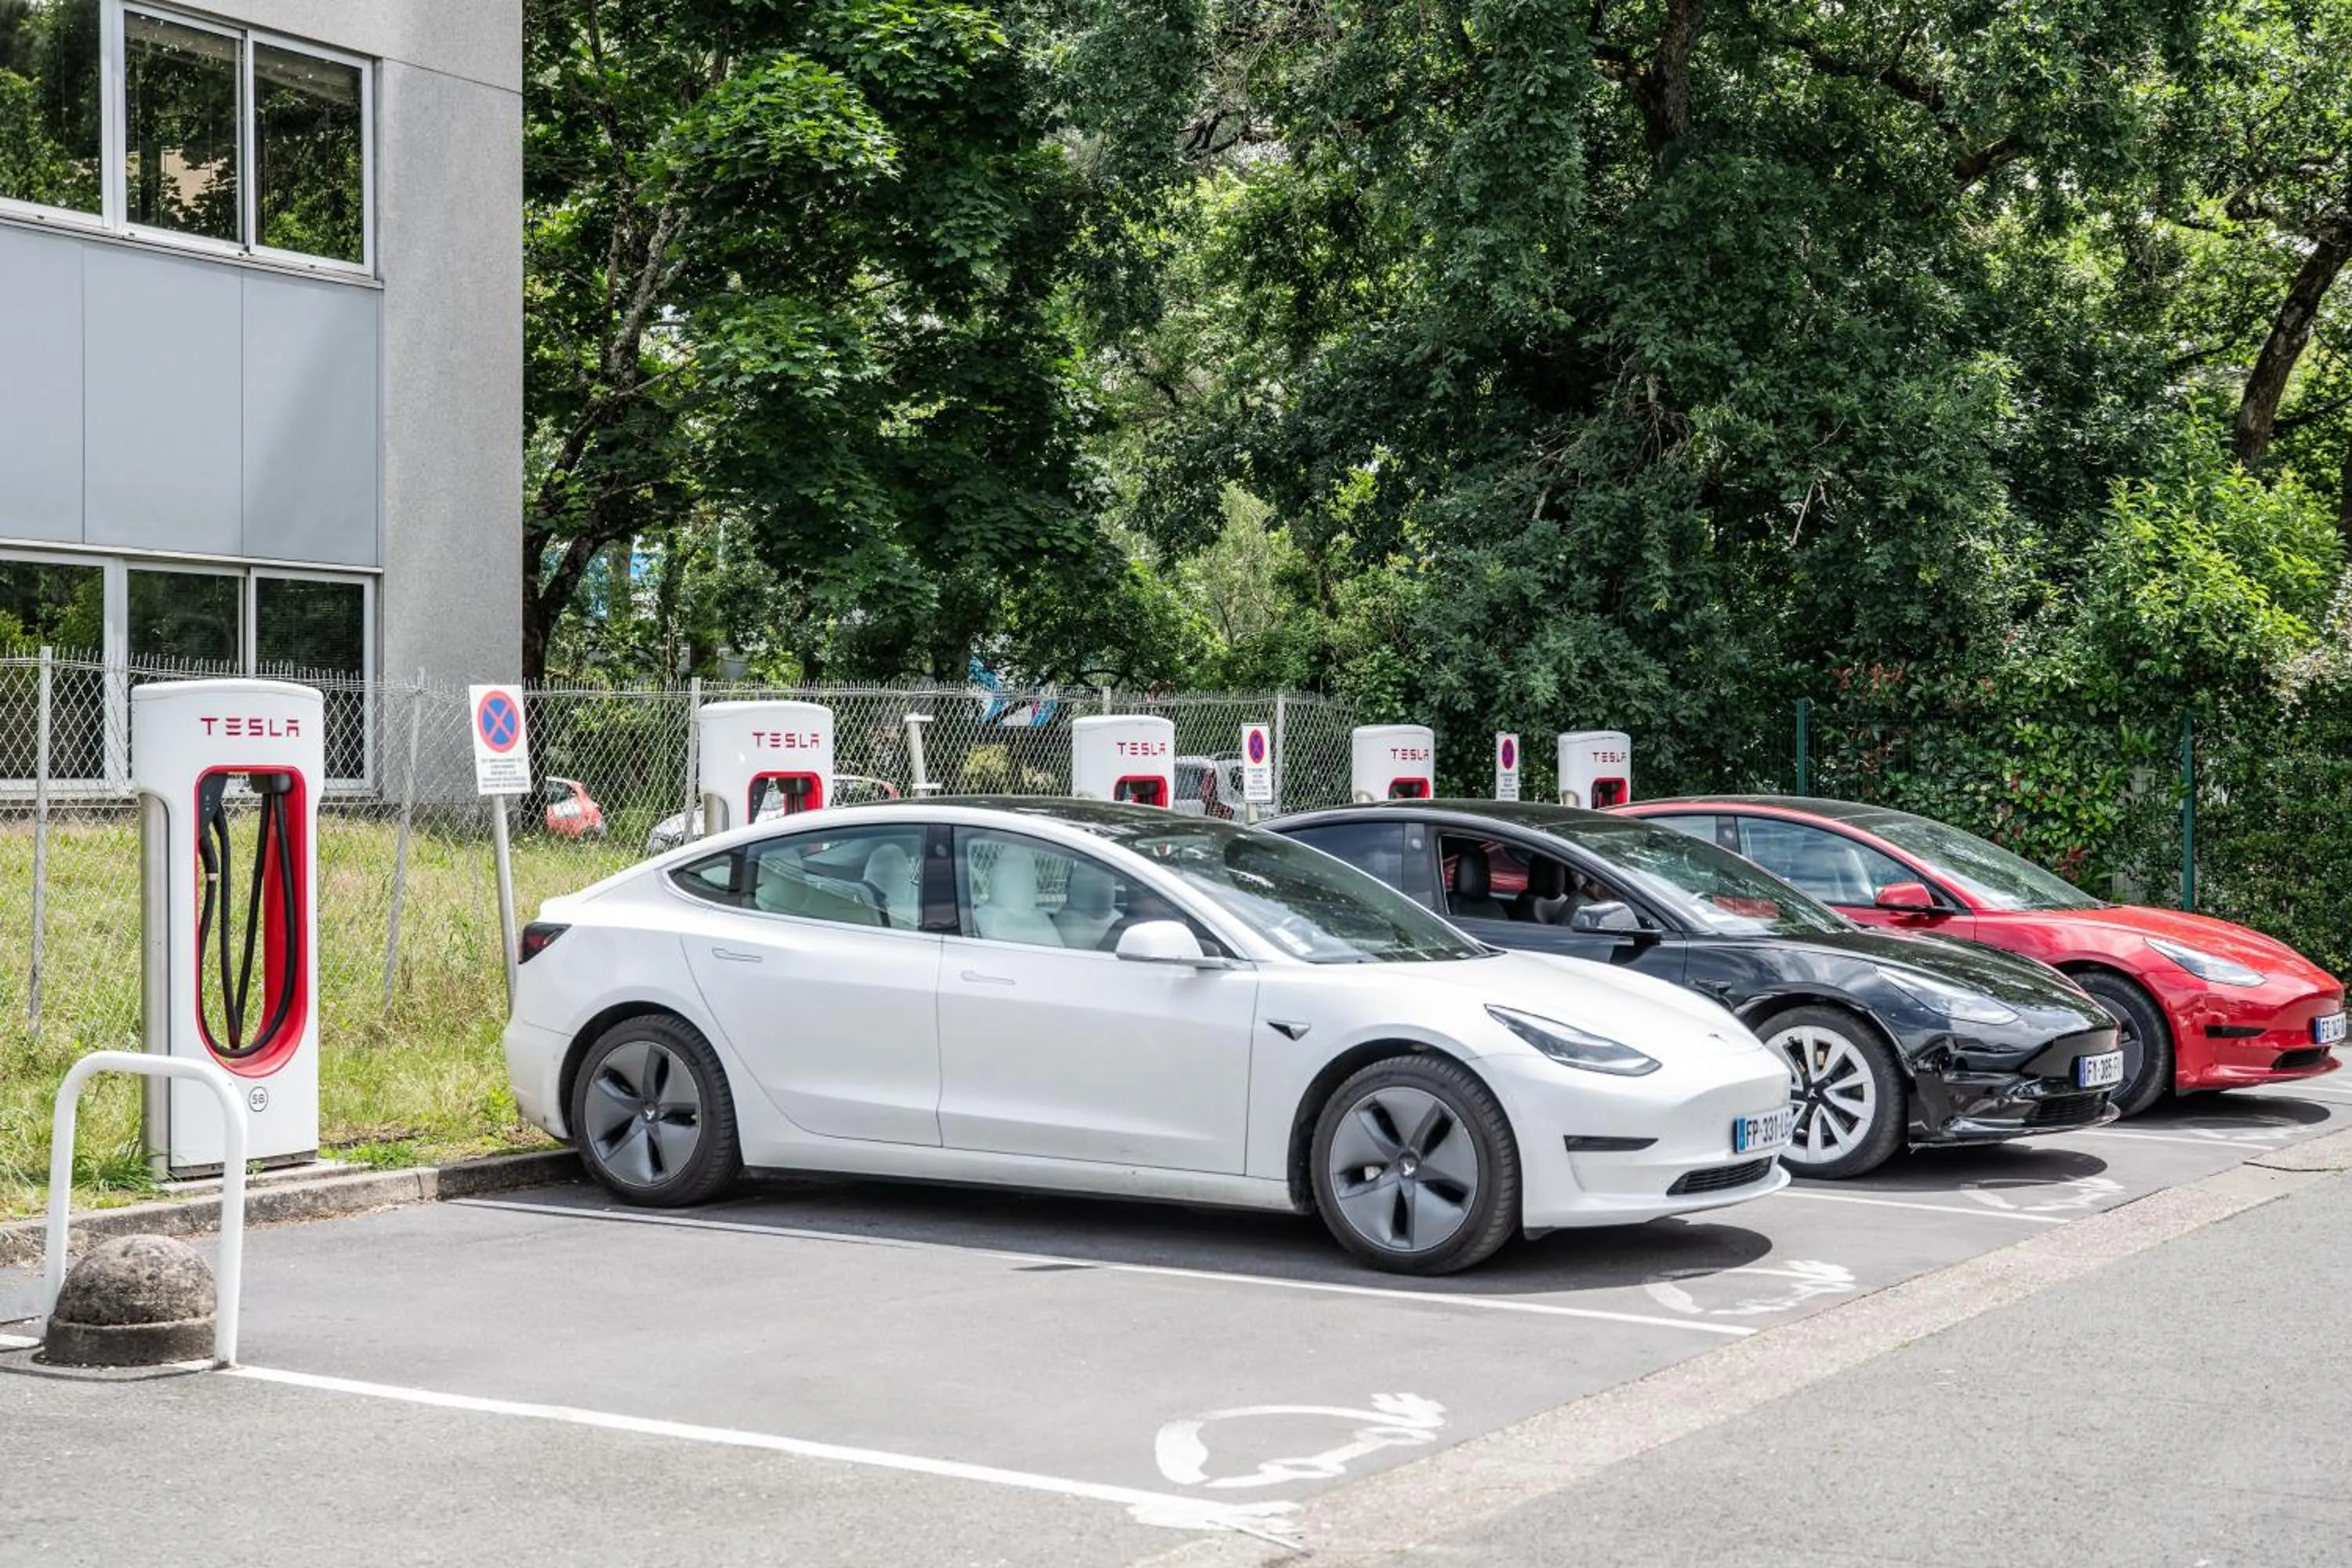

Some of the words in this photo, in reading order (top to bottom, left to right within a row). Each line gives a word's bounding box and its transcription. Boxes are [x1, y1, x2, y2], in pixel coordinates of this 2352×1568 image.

[200, 717, 299, 737] TESLA
[752, 731, 819, 749] TESLA
[1116, 742, 1166, 756] TESLA
[1390, 748, 1429, 762] TESLA
[1592, 752, 1627, 763] TESLA
